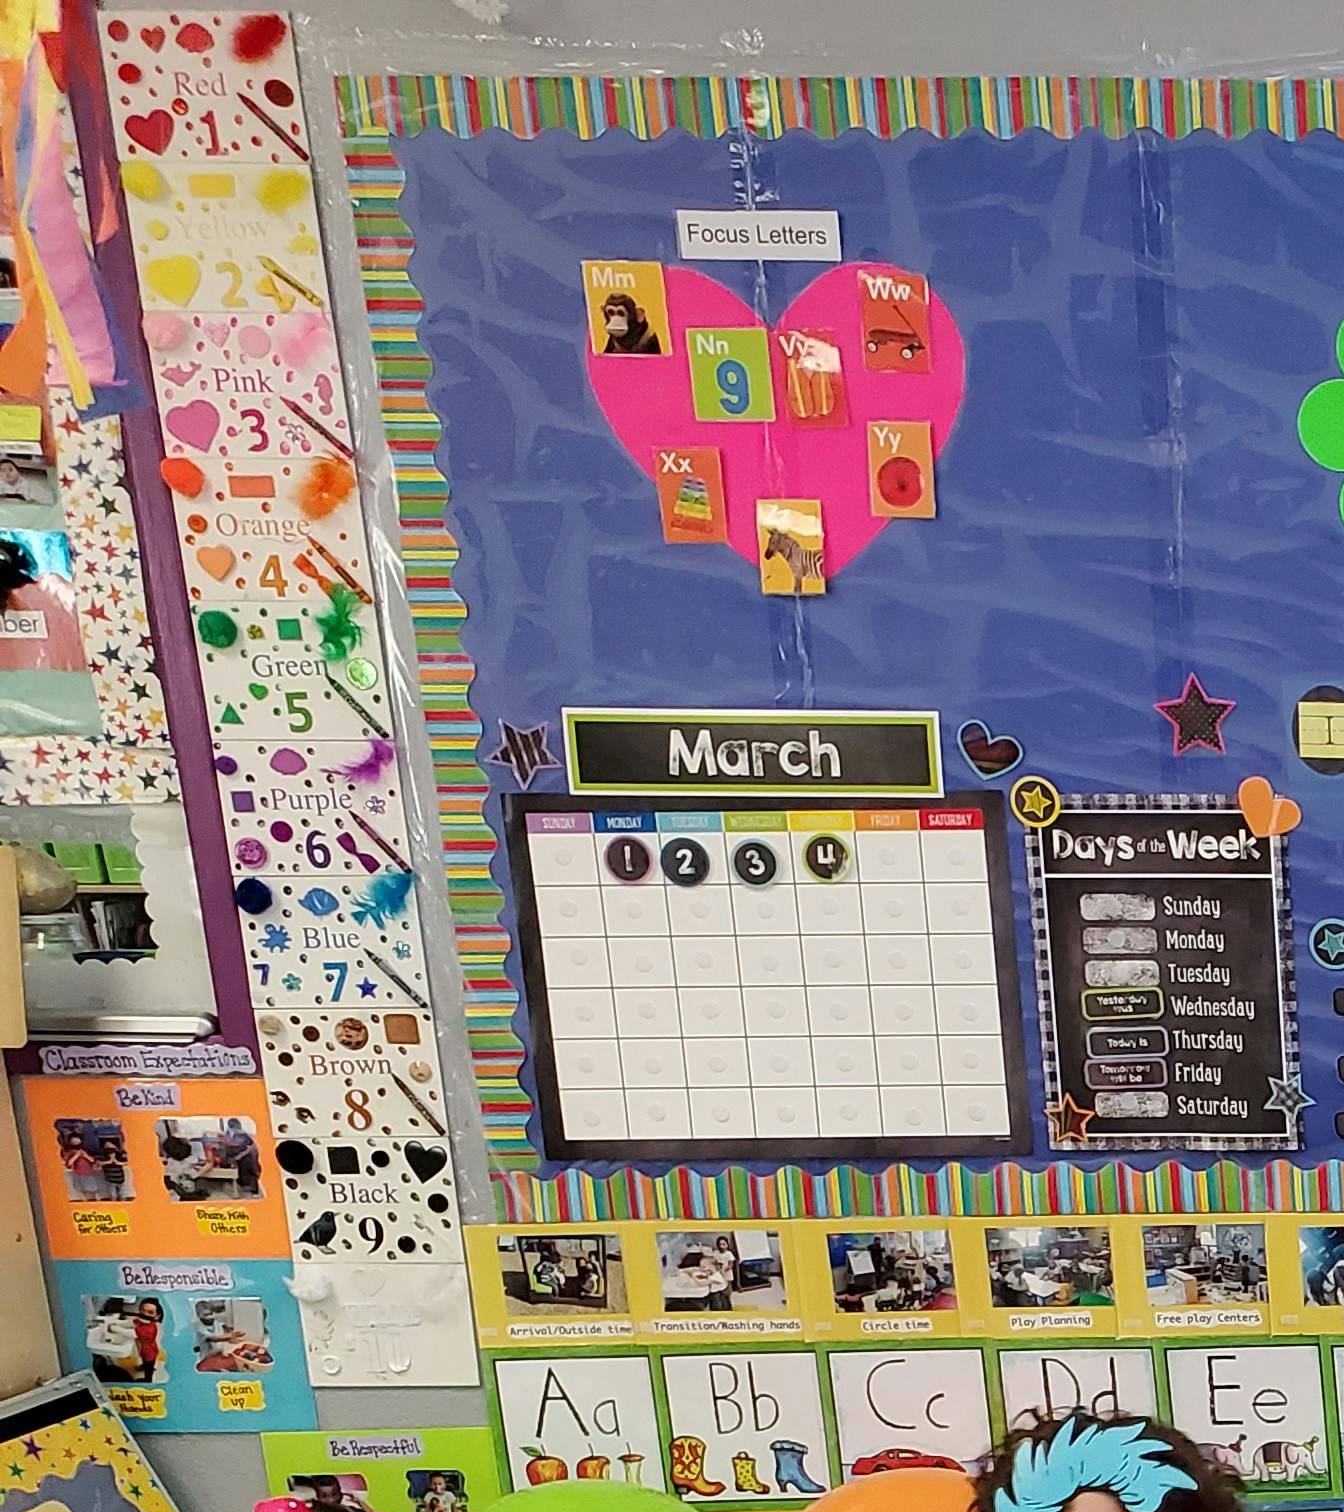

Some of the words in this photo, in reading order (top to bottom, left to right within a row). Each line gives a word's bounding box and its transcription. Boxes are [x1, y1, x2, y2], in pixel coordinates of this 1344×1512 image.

[173, 72, 226, 97] Red
[200, 111, 229, 157] 1
[176, 213, 269, 240] Yellow
[687, 222, 751, 244] Focus
[756, 225, 827, 245] Letters
[215, 261, 248, 306] 2
[592, 267, 636, 288] Mm
[696, 335, 729, 355] Nn
[212, 368, 273, 394] Pink
[240, 410, 269, 451] 3
[873, 426, 902, 454] Yy
[660, 452, 693, 473] Xx
[215, 513, 311, 540] Orange
[259, 555, 288, 597] 4
[252, 656, 328, 678] Green
[286, 692, 313, 733] 5
[668, 728, 842, 778] March
[271, 788, 351, 812] Purple
[606, 816, 643, 830] MONDAY
[928, 813, 973, 827] SATURDAY
[306, 830, 331, 870] 6
[1052, 829, 1135, 866] Days
[1167, 829, 1262, 860] Week
[676, 850, 696, 875] 2
[745, 850, 766, 875] 3
[1163, 897, 1221, 919] Sunday
[303, 928, 361, 949] Blue
[1166, 930, 1225, 952] Monday
[324, 963, 349, 1002] 7
[1168, 964, 1231, 986] Tuesday
[1171, 996, 1255, 1020] Wednesday
[1173, 1031, 1244, 1053] Thursday
[44, 1050, 137, 1070] Classroom
[141, 1049, 250, 1069] Expectations
[310, 1055, 391, 1076] Brown
[1175, 1063, 1222, 1086] Friday
[117, 1089, 142, 1108] Be
[144, 1088, 174, 1107] Kind
[1177, 1098, 1248, 1118] Saturday
[346, 1089, 372, 1131] 8
[330, 1183, 398, 1204] Black
[211, 1223, 247, 1233] Others
[359, 1217, 384, 1255] 9
[122, 1266, 142, 1285] Be
[143, 1267, 228, 1288] Responsible
[770, 1319, 801, 1332] hands
[862, 1320, 895, 1332] Circle
[900, 1319, 930, 1330] time
[1011, 1316, 1037, 1329] Play
[1041, 1315, 1091, 1328] Planning
[1157, 1312, 1183, 1325] Free
[1187, 1313, 1213, 1325] play
[1217, 1311, 1260, 1323] Centers
[607, 1324, 633, 1335] time
[330, 1441, 350, 1456] Be
